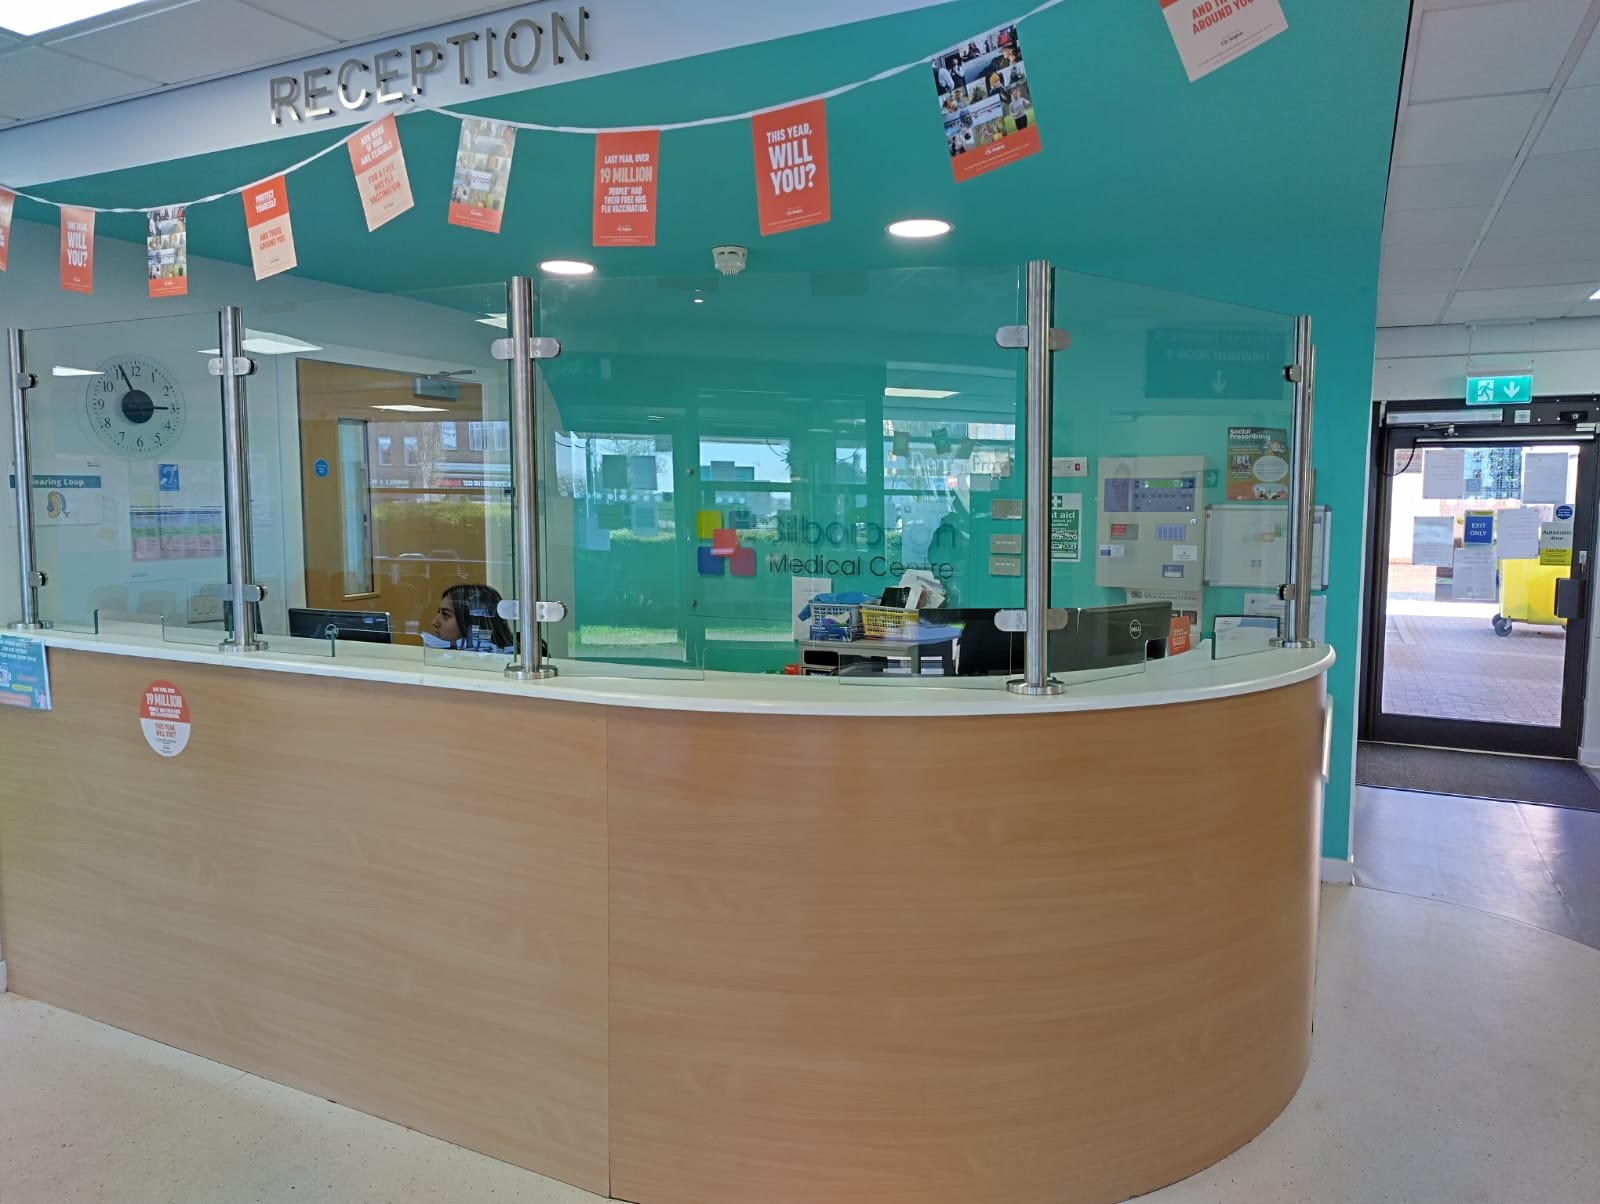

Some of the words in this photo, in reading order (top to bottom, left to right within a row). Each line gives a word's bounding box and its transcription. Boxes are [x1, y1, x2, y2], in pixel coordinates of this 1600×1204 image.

[1192, 1, 1212, 20] AND
[1192, 4, 1232, 35] AROUND
[269, 6, 591, 126] RECEPTION
[766, 129, 785, 144] THIS
[787, 123, 812, 139] YEAR,
[604, 155, 618, 164] LAST
[635, 153, 650, 163] OVER
[768, 138, 813, 170] WILL
[600, 167, 611, 183] 19
[612, 166, 653, 183] MILLION
[770, 163, 816, 195] YOU?
[67, 231, 88, 249] WILL
[67, 248, 88, 268] YOU?
[131, 366, 141, 377] 12
[103, 381, 114, 392] 10
[163, 385, 169, 396] 2
[97, 399, 105, 410] 9
[104, 417, 111, 428] 8
[163, 421, 171, 430] 4
[118, 431, 126, 442] 7
[136, 437, 144, 447] 6
[154, 432, 161, 443] 5
[1229, 433, 1271, 441] Prescribing
[63, 478, 84, 488] Loop
[1060, 511, 1075, 519] aid
[768, 553, 862, 577] Medical
[146, 693, 154, 705] 19
[155, 693, 182, 708] MILLION
